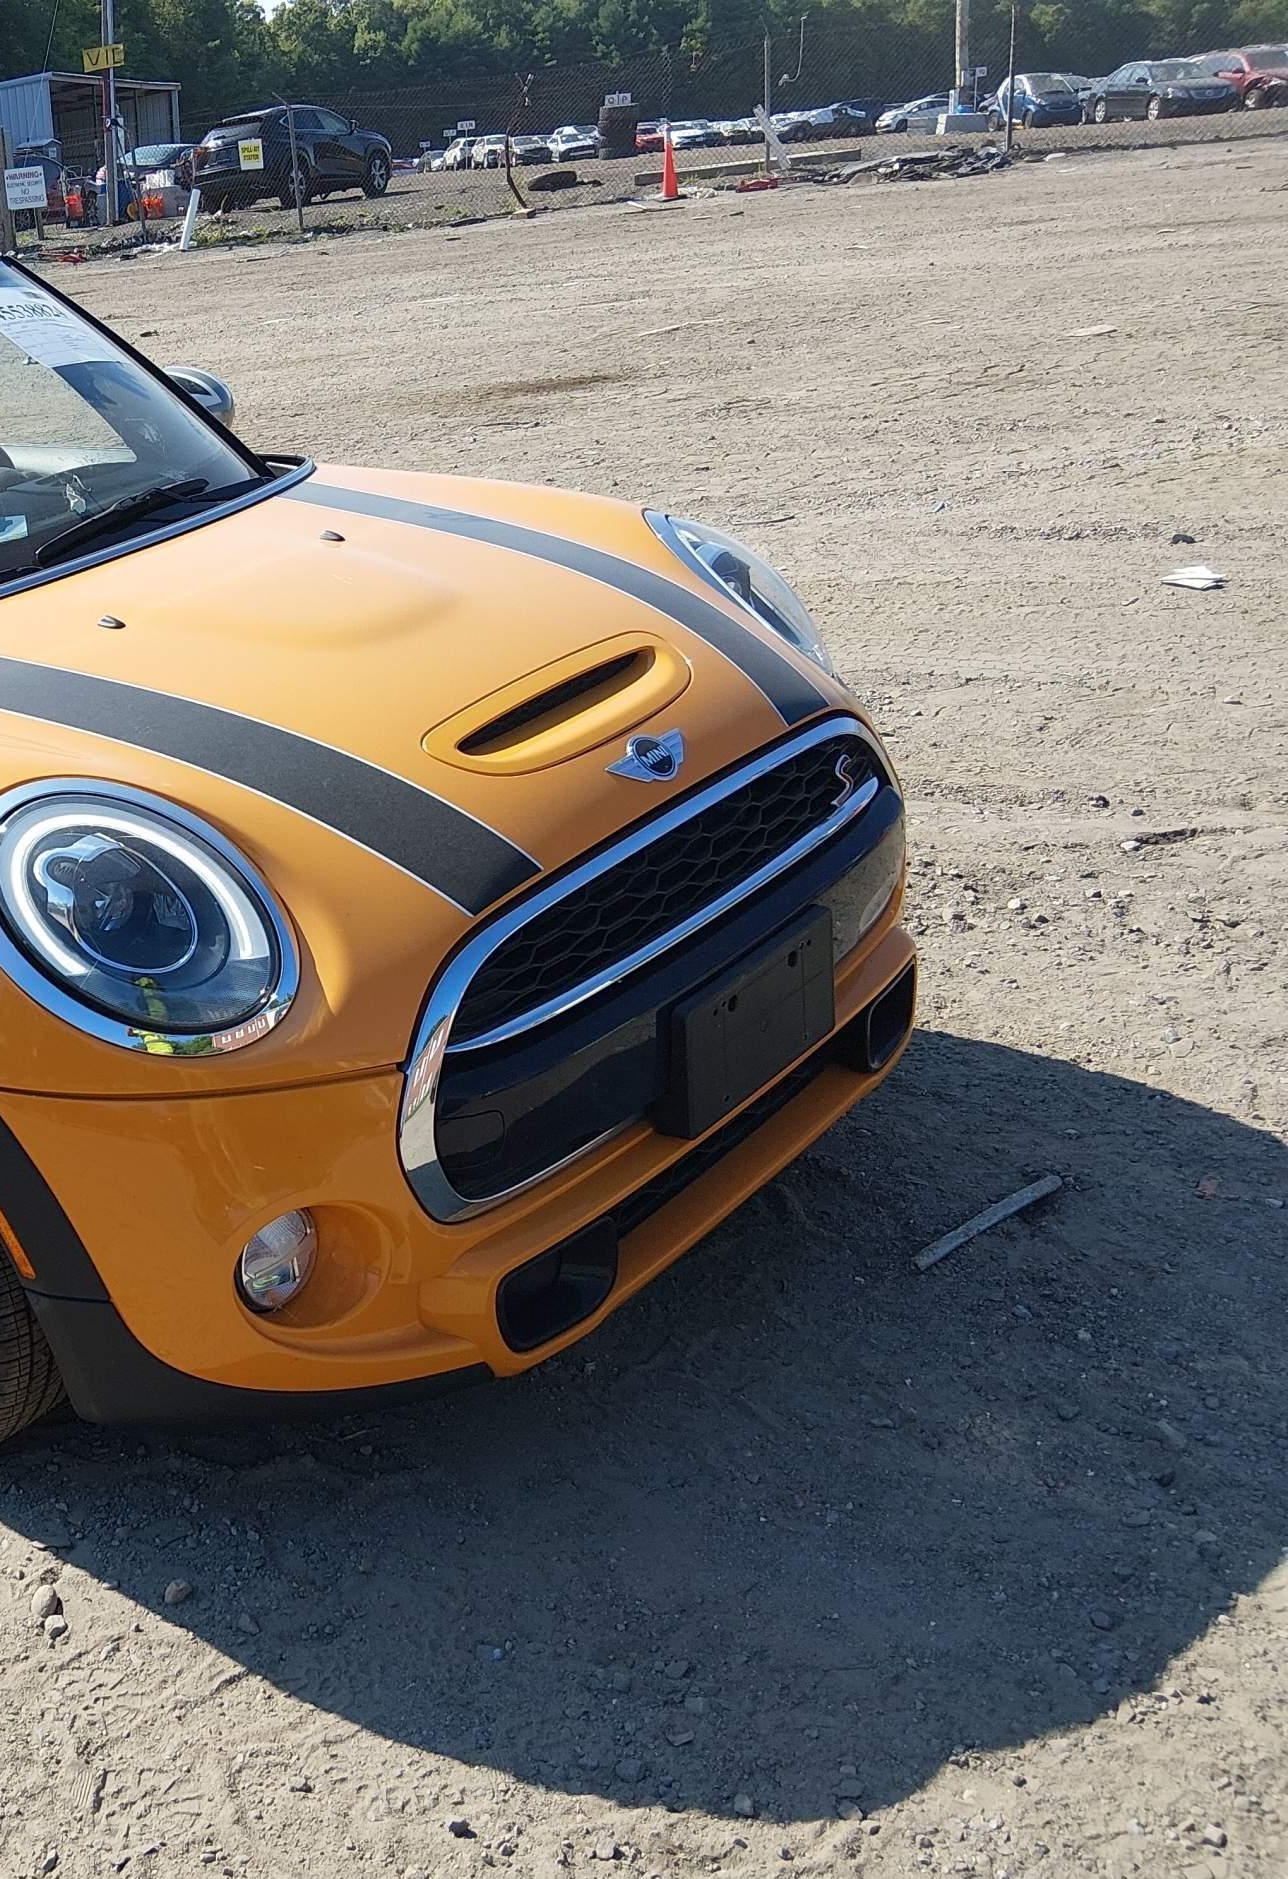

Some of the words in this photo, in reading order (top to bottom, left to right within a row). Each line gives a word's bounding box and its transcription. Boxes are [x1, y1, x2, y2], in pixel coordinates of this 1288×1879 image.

[8, 171, 40, 180] WARNING
[9, 195, 45, 204] TRESPASSING
[640, 745, 669, 766] MINI
